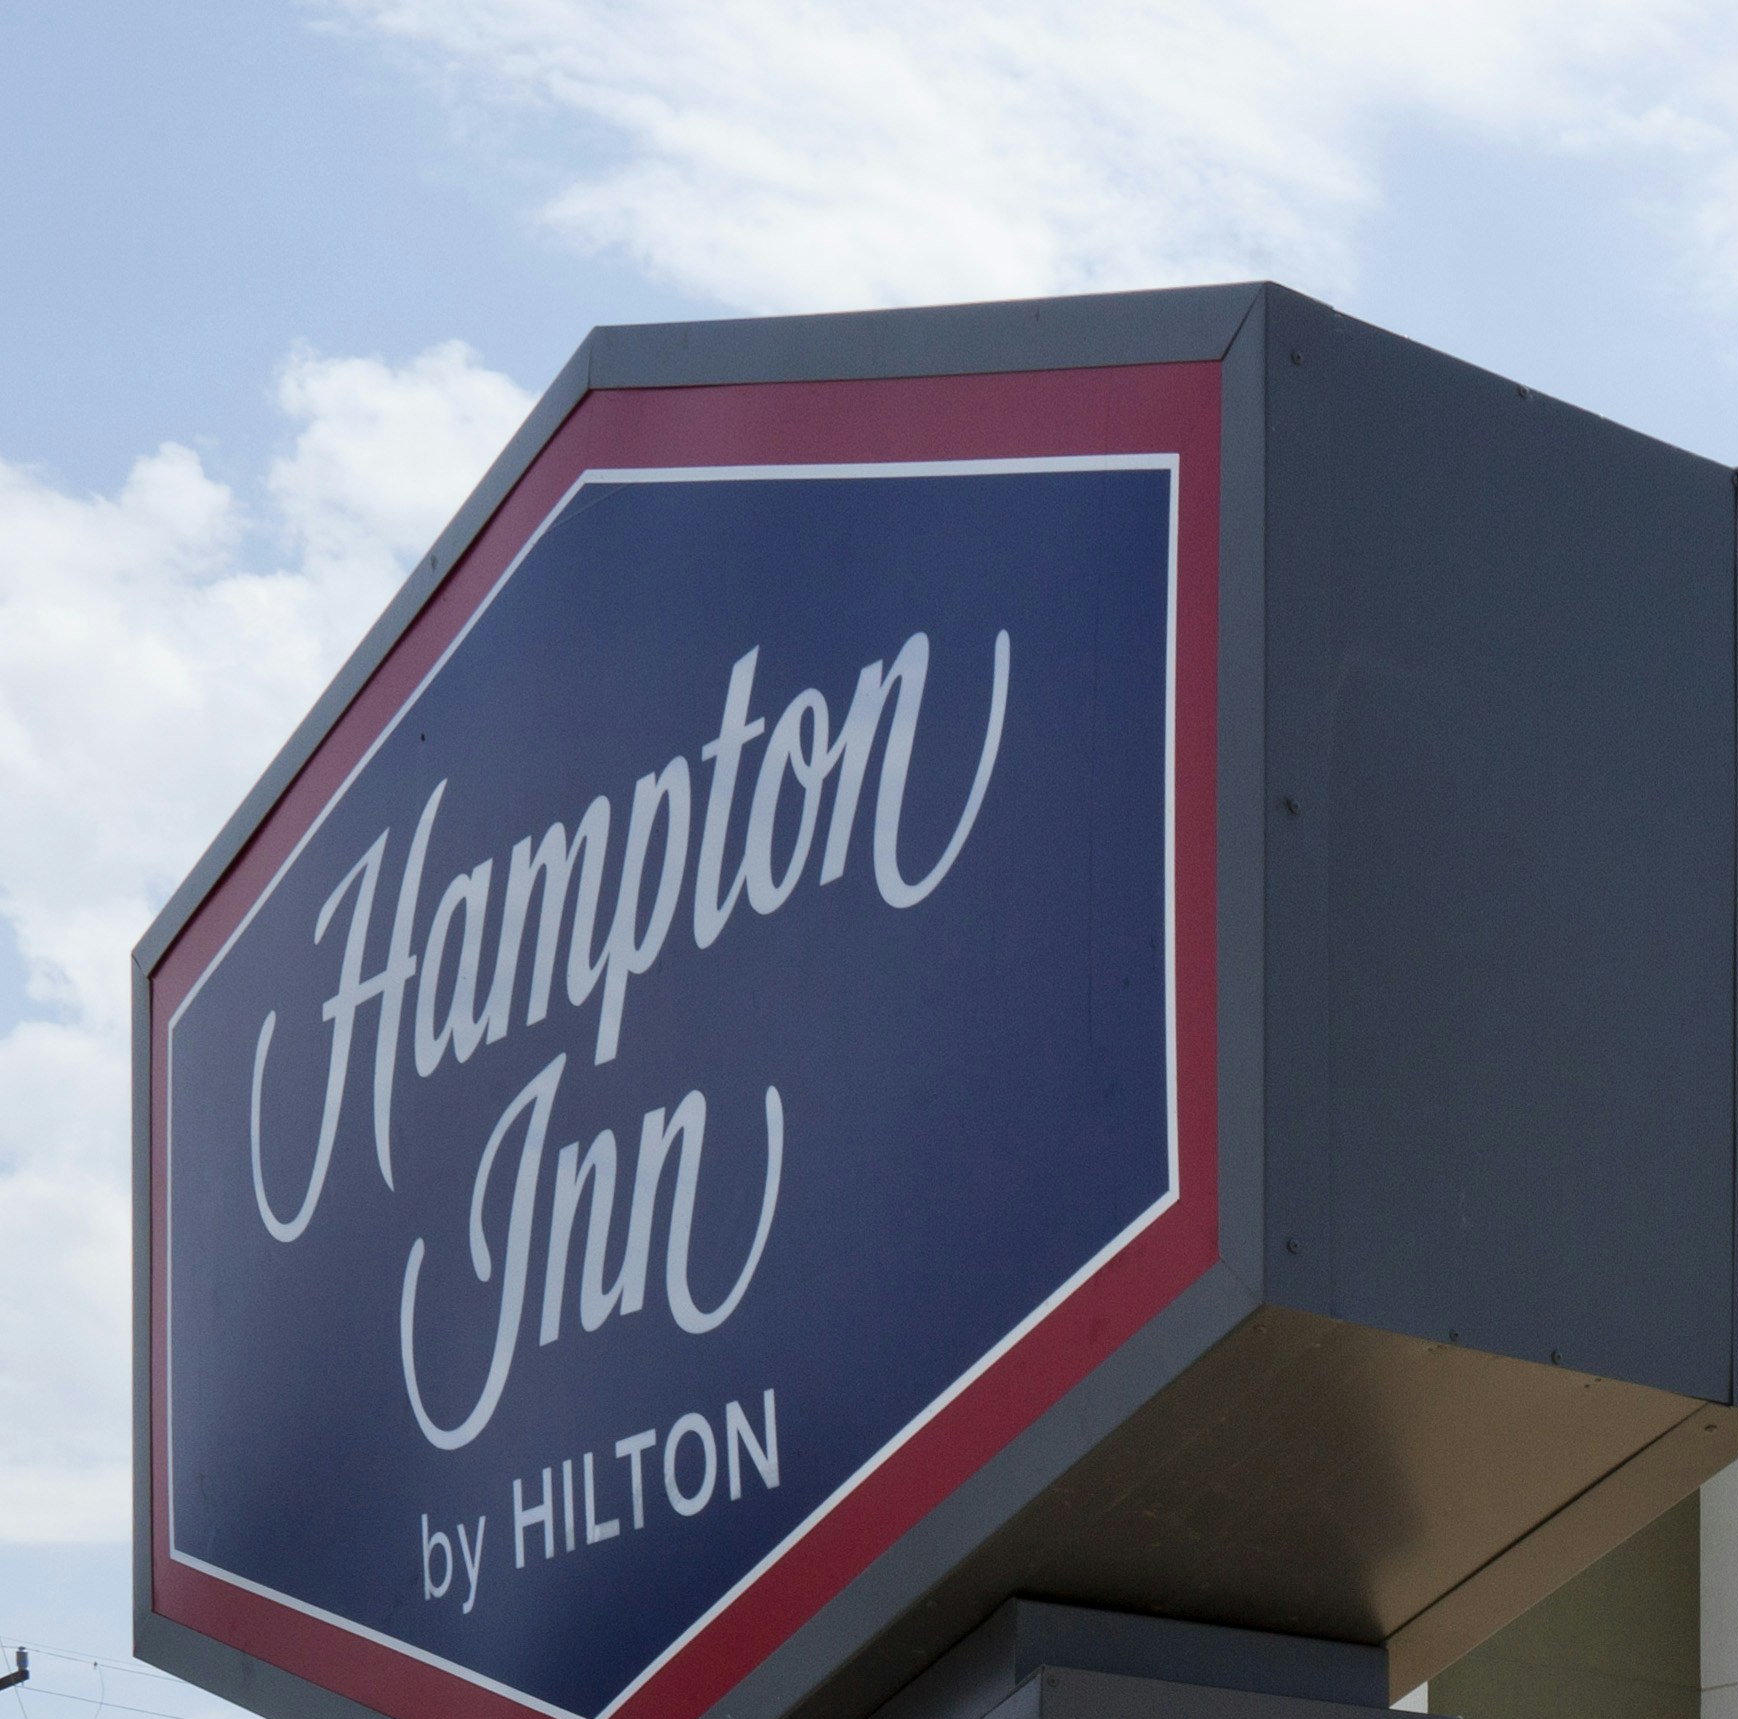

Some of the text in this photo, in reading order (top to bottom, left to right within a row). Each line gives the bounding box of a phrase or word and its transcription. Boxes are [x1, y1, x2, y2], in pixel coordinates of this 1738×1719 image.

[250, 630, 1011, 1243] Hampton
[400, 1052, 784, 1451] Inn
[422, 1389, 779, 1614] by HILTON
